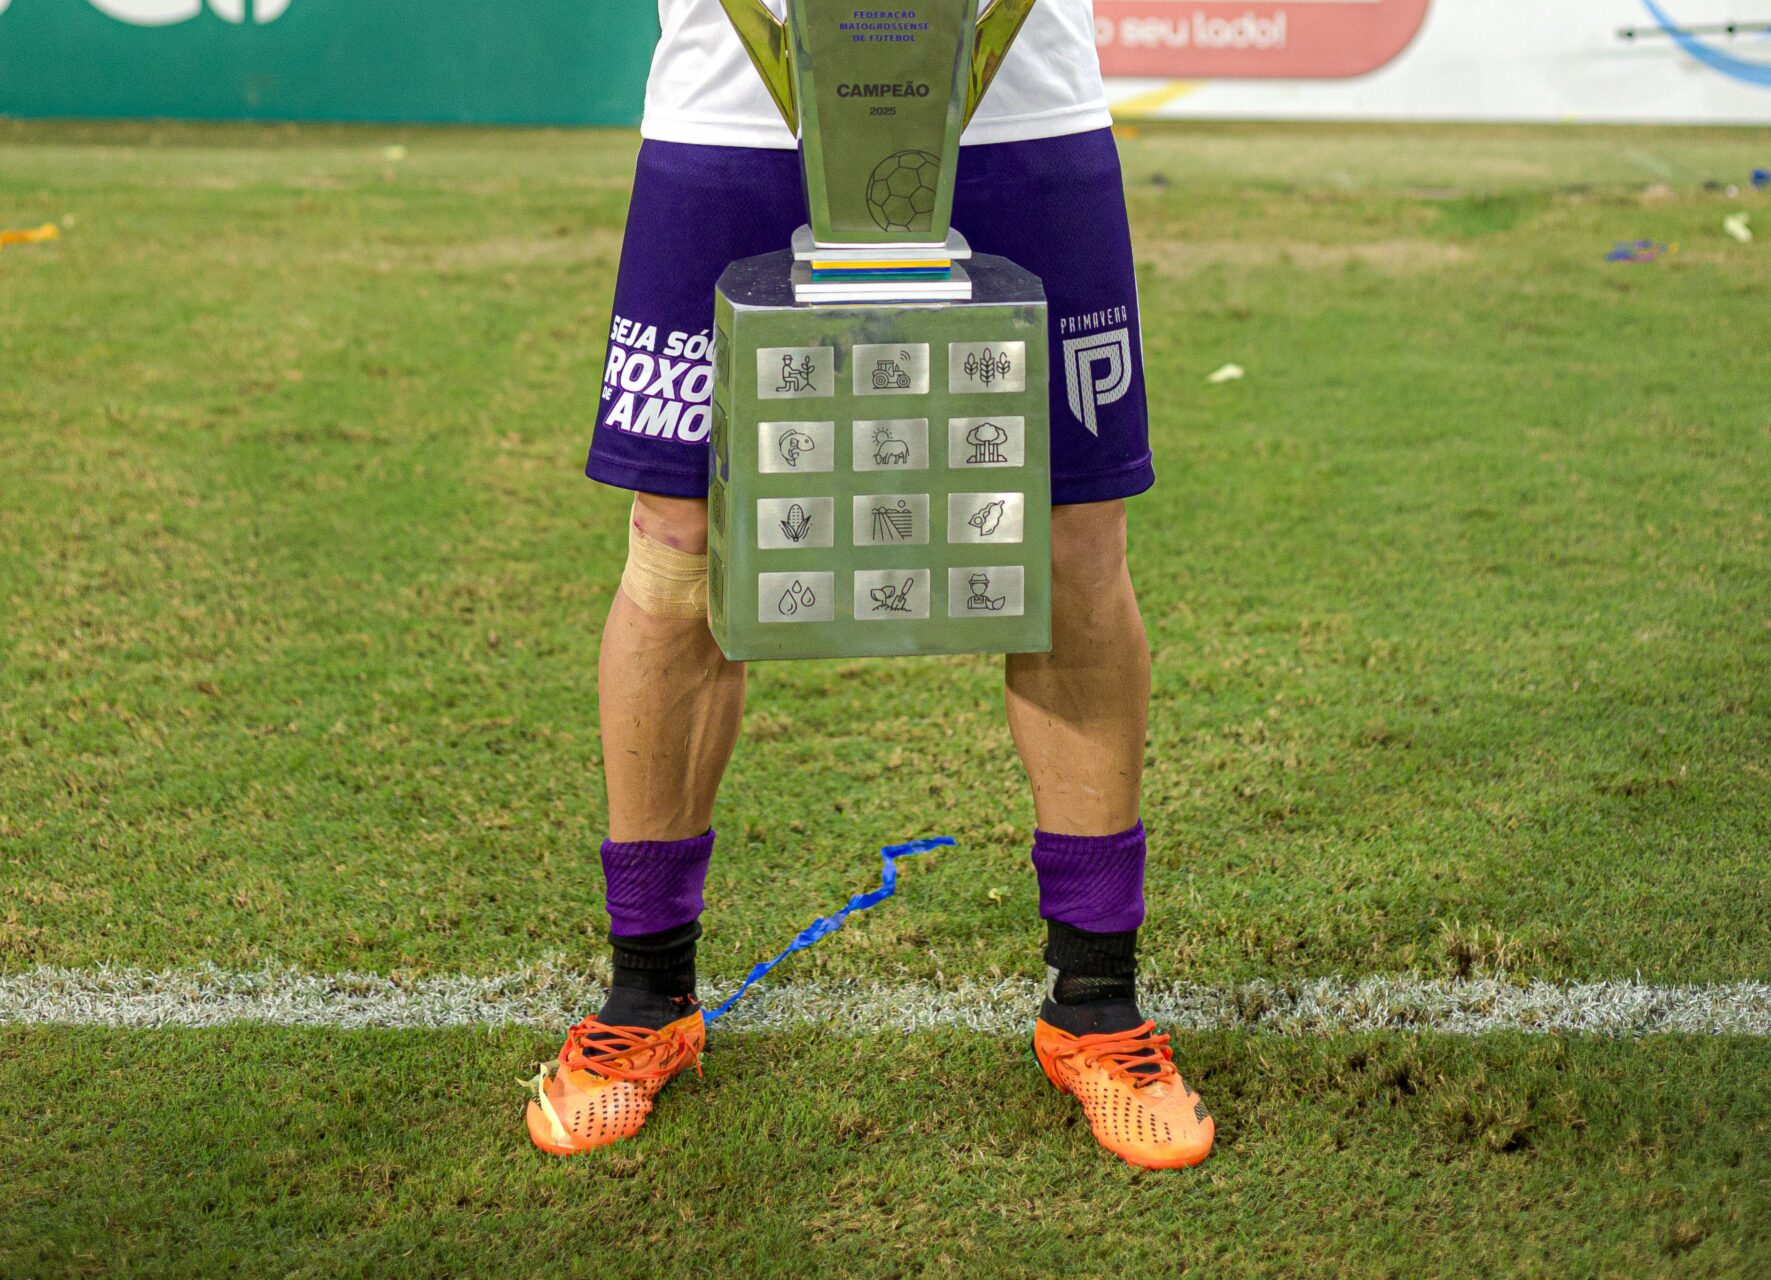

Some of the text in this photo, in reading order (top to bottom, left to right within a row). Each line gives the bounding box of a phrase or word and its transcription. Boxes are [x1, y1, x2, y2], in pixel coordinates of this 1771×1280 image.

[839, 22, 929, 31] MATOGROSSENSE
[853, 34, 866, 42] DE
[836, 81, 930, 98] CAMPEÃO
[869, 106, 897, 116] 2025
[1060, 305, 1128, 335] PRIMAVERA
[610, 314, 657, 352] SEJA
[604, 345, 713, 403] ROXO
[604, 391, 712, 443] AMO
